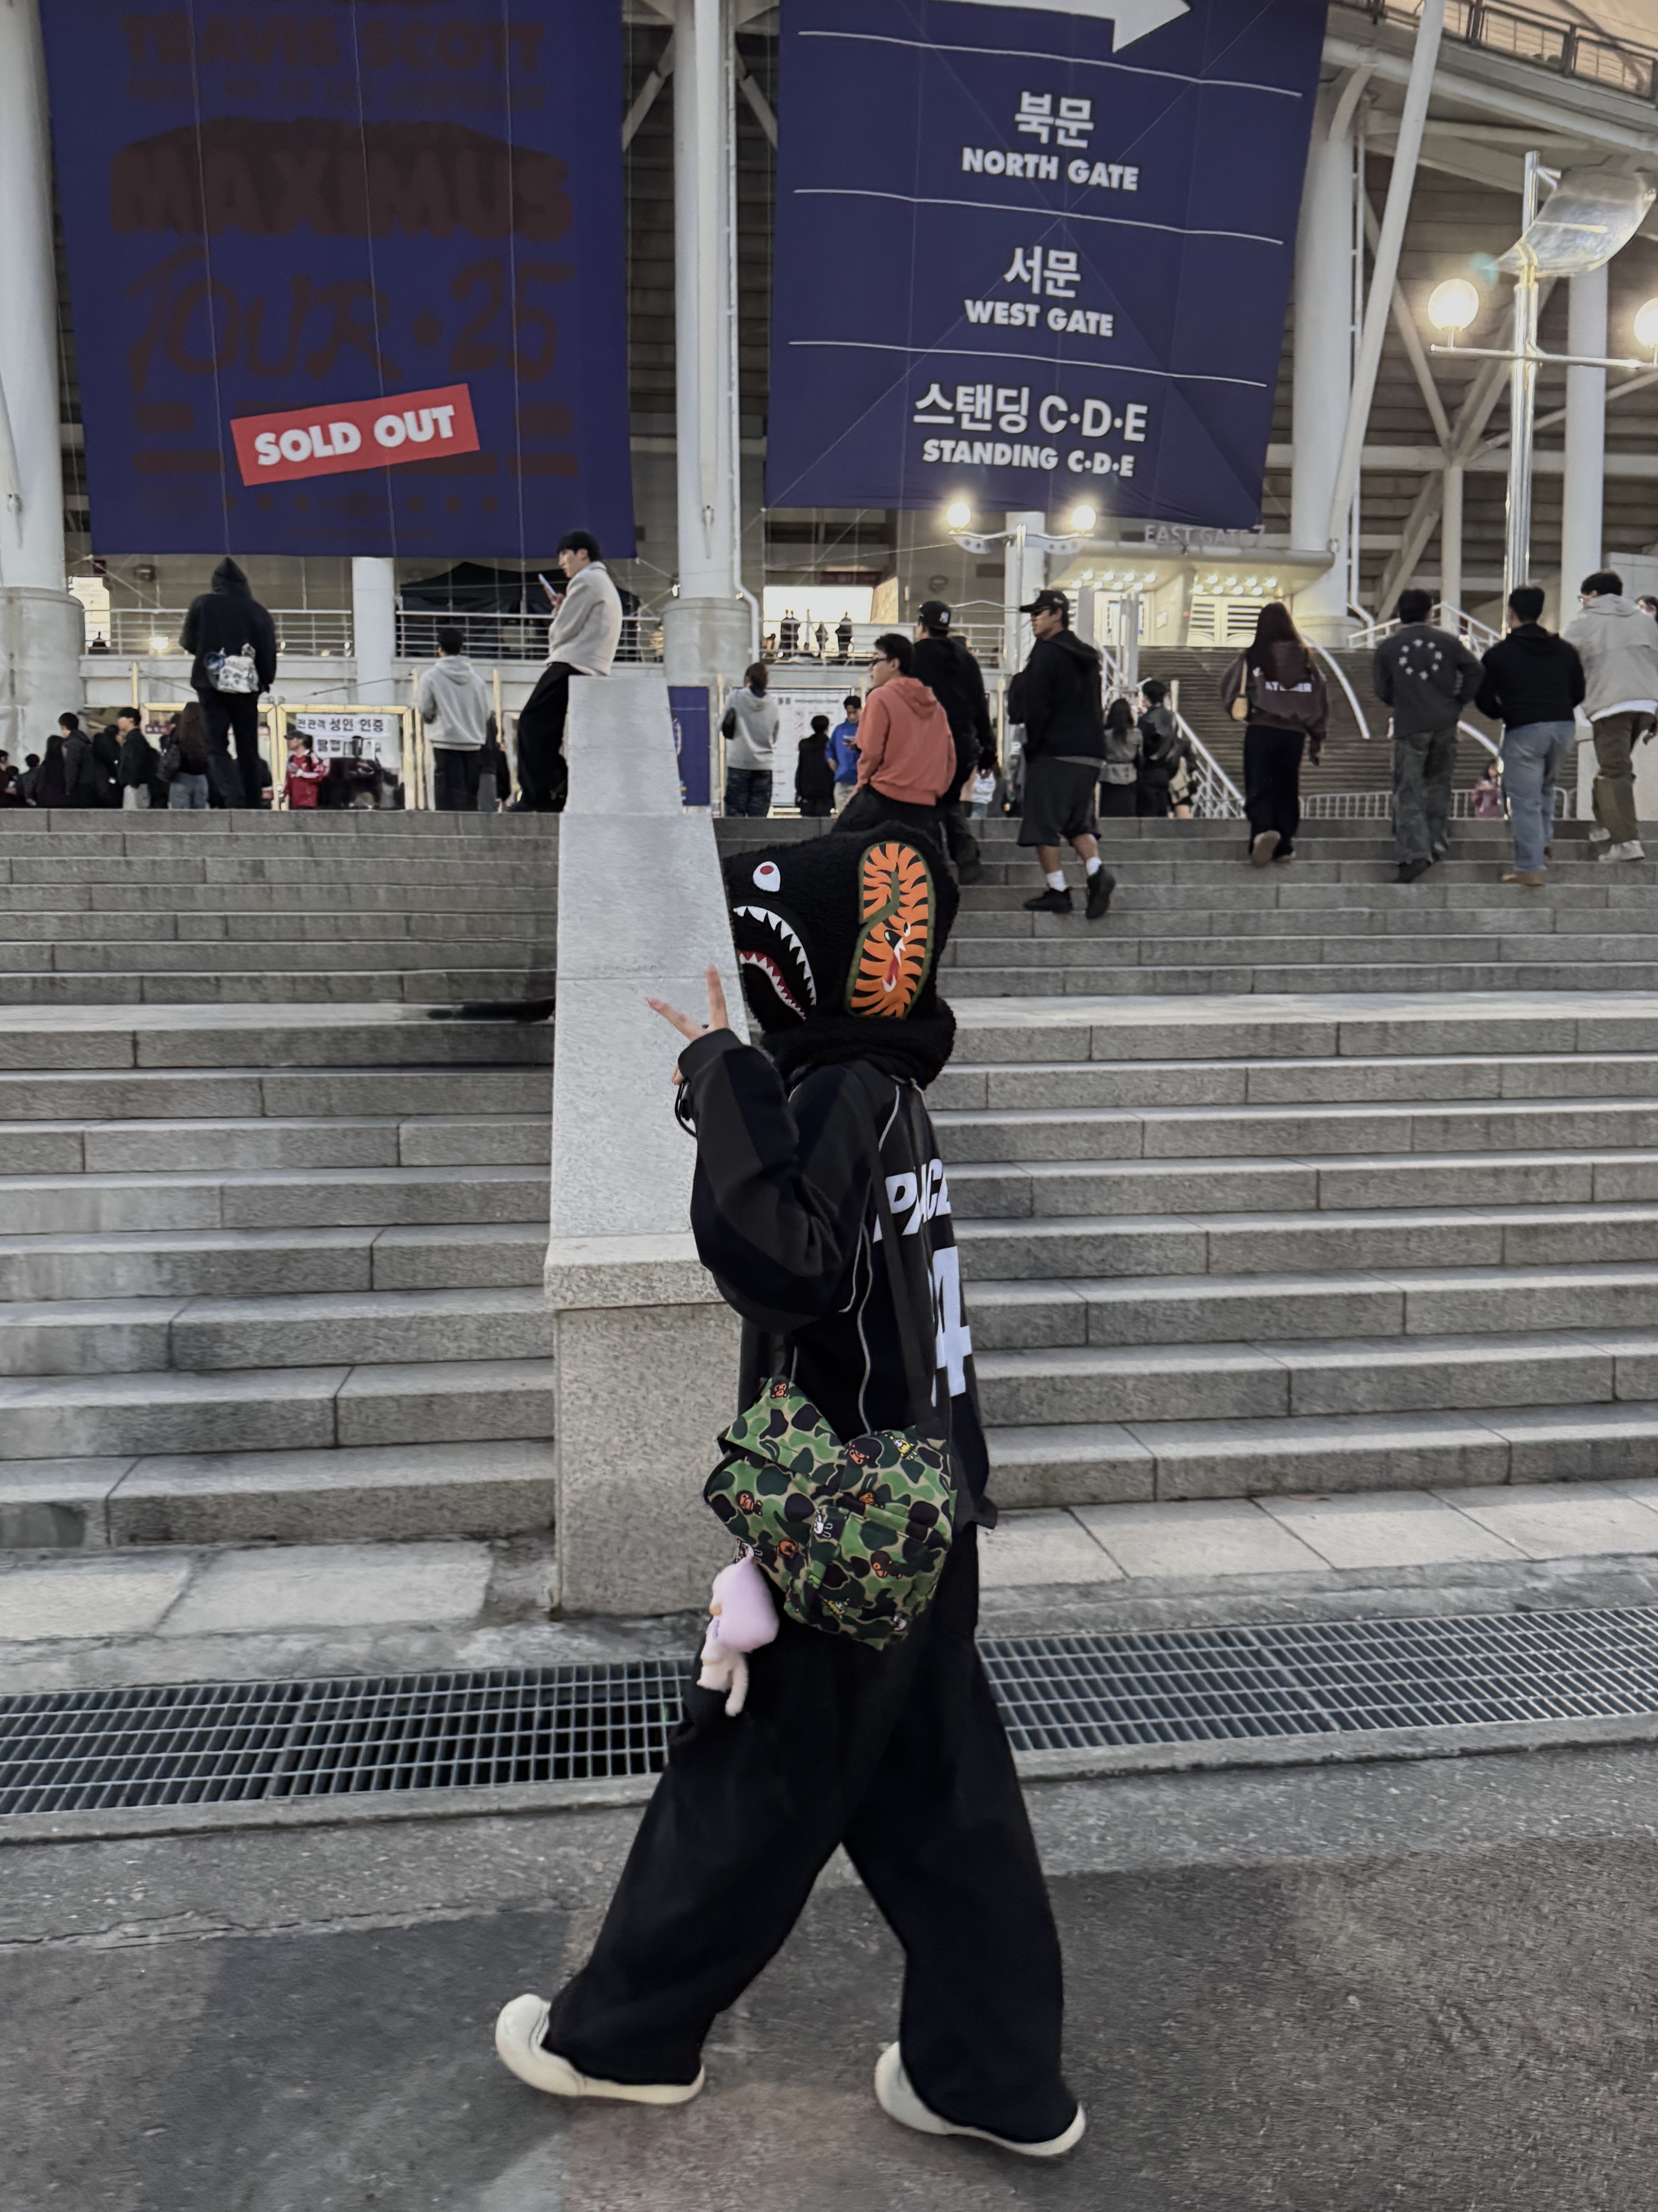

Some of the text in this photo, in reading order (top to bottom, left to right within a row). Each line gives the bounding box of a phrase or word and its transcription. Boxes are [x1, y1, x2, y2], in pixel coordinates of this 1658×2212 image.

[119, 11, 547, 72] TRAVIS SCOTT
[1014, 91, 1094, 148] 북문
[110, 124, 573, 242] MAXIMUS
[962, 147, 1139, 191] NORTH GATE
[1003, 246, 1081, 298] 서문
[125, 245, 576, 393] TOUR 25
[964, 300, 1114, 337] WEST GATE
[913, 383, 1030, 434] 스탠딩
[254, 422, 362, 466] SOLD
[373, 405, 455, 447] OUT
[922, 439, 1059, 470] STANDING
[1145, 525, 1192, 544] EAST
[329, 718, 354, 732] 성인
[360, 718, 384, 732] 인증
